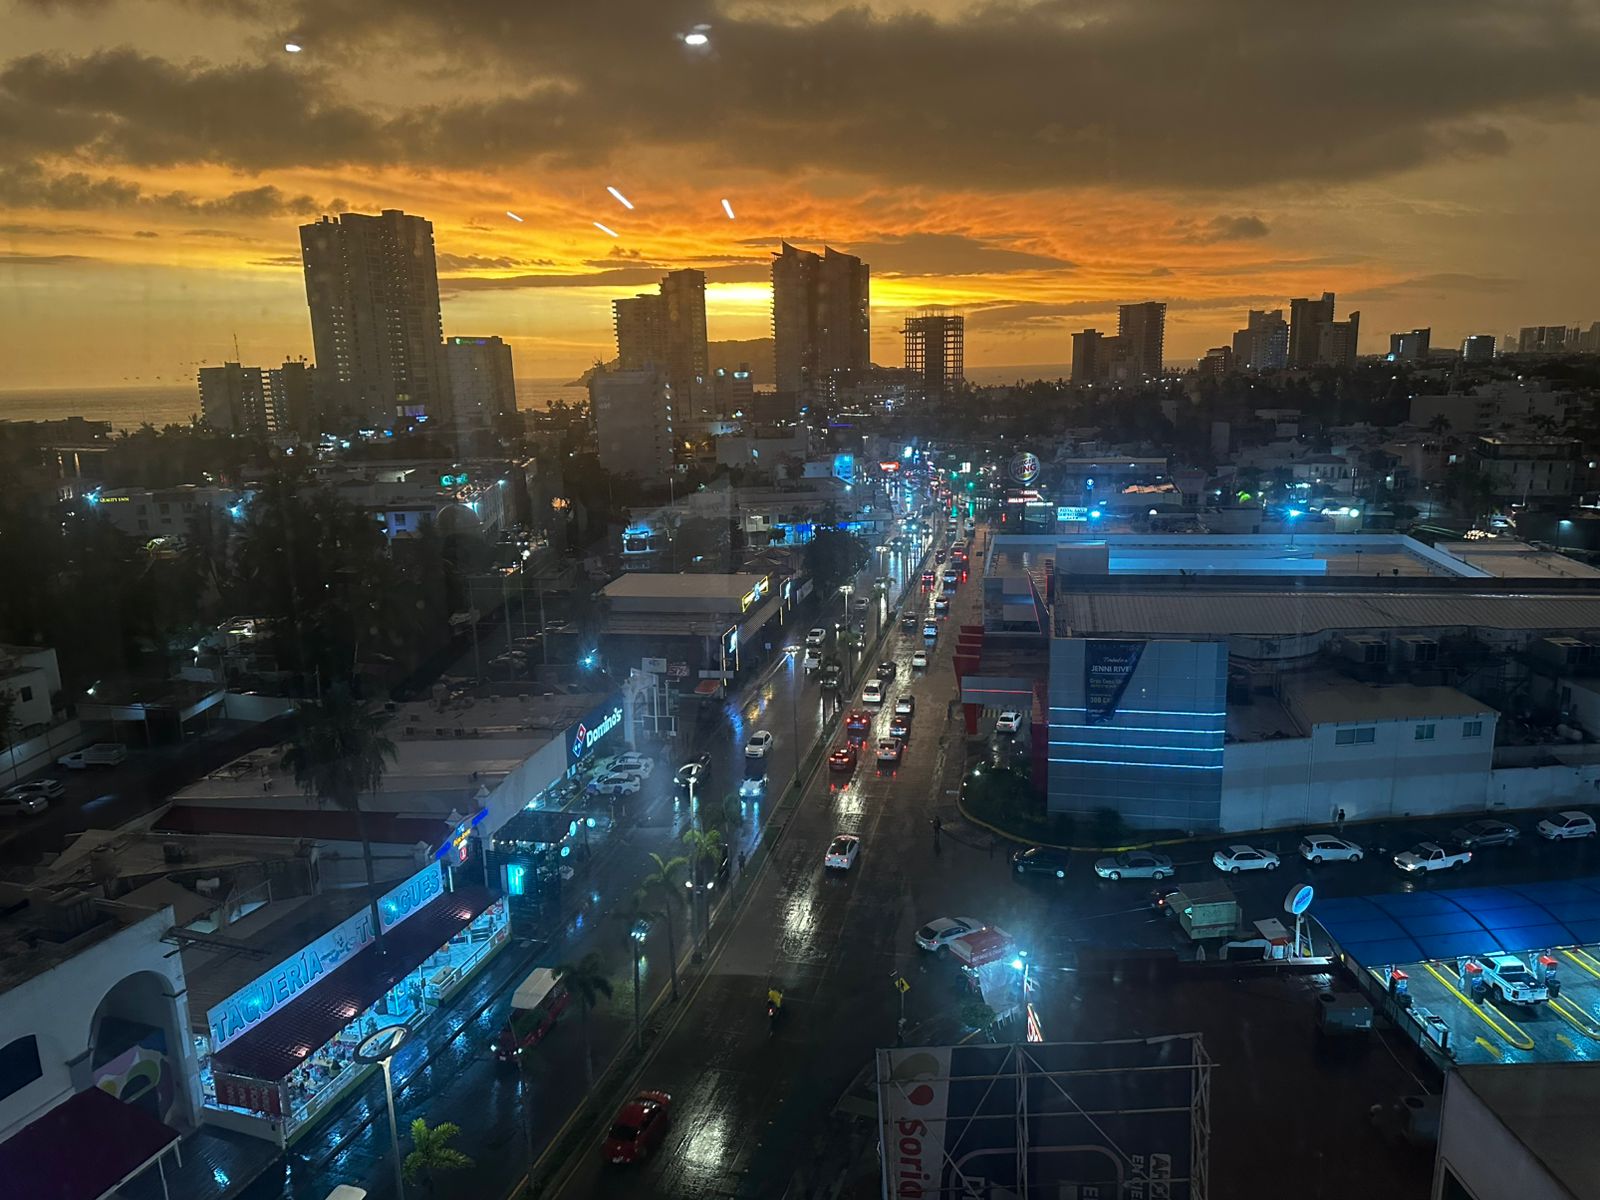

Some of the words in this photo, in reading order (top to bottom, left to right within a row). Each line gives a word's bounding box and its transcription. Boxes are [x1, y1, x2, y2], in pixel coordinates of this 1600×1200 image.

[1091, 665, 1112, 673] JENNI
[586, 707, 622, 748] Domino's
[212, 952, 324, 1043] TAQUERÍA
[382, 869, 440, 927] SIGUES
